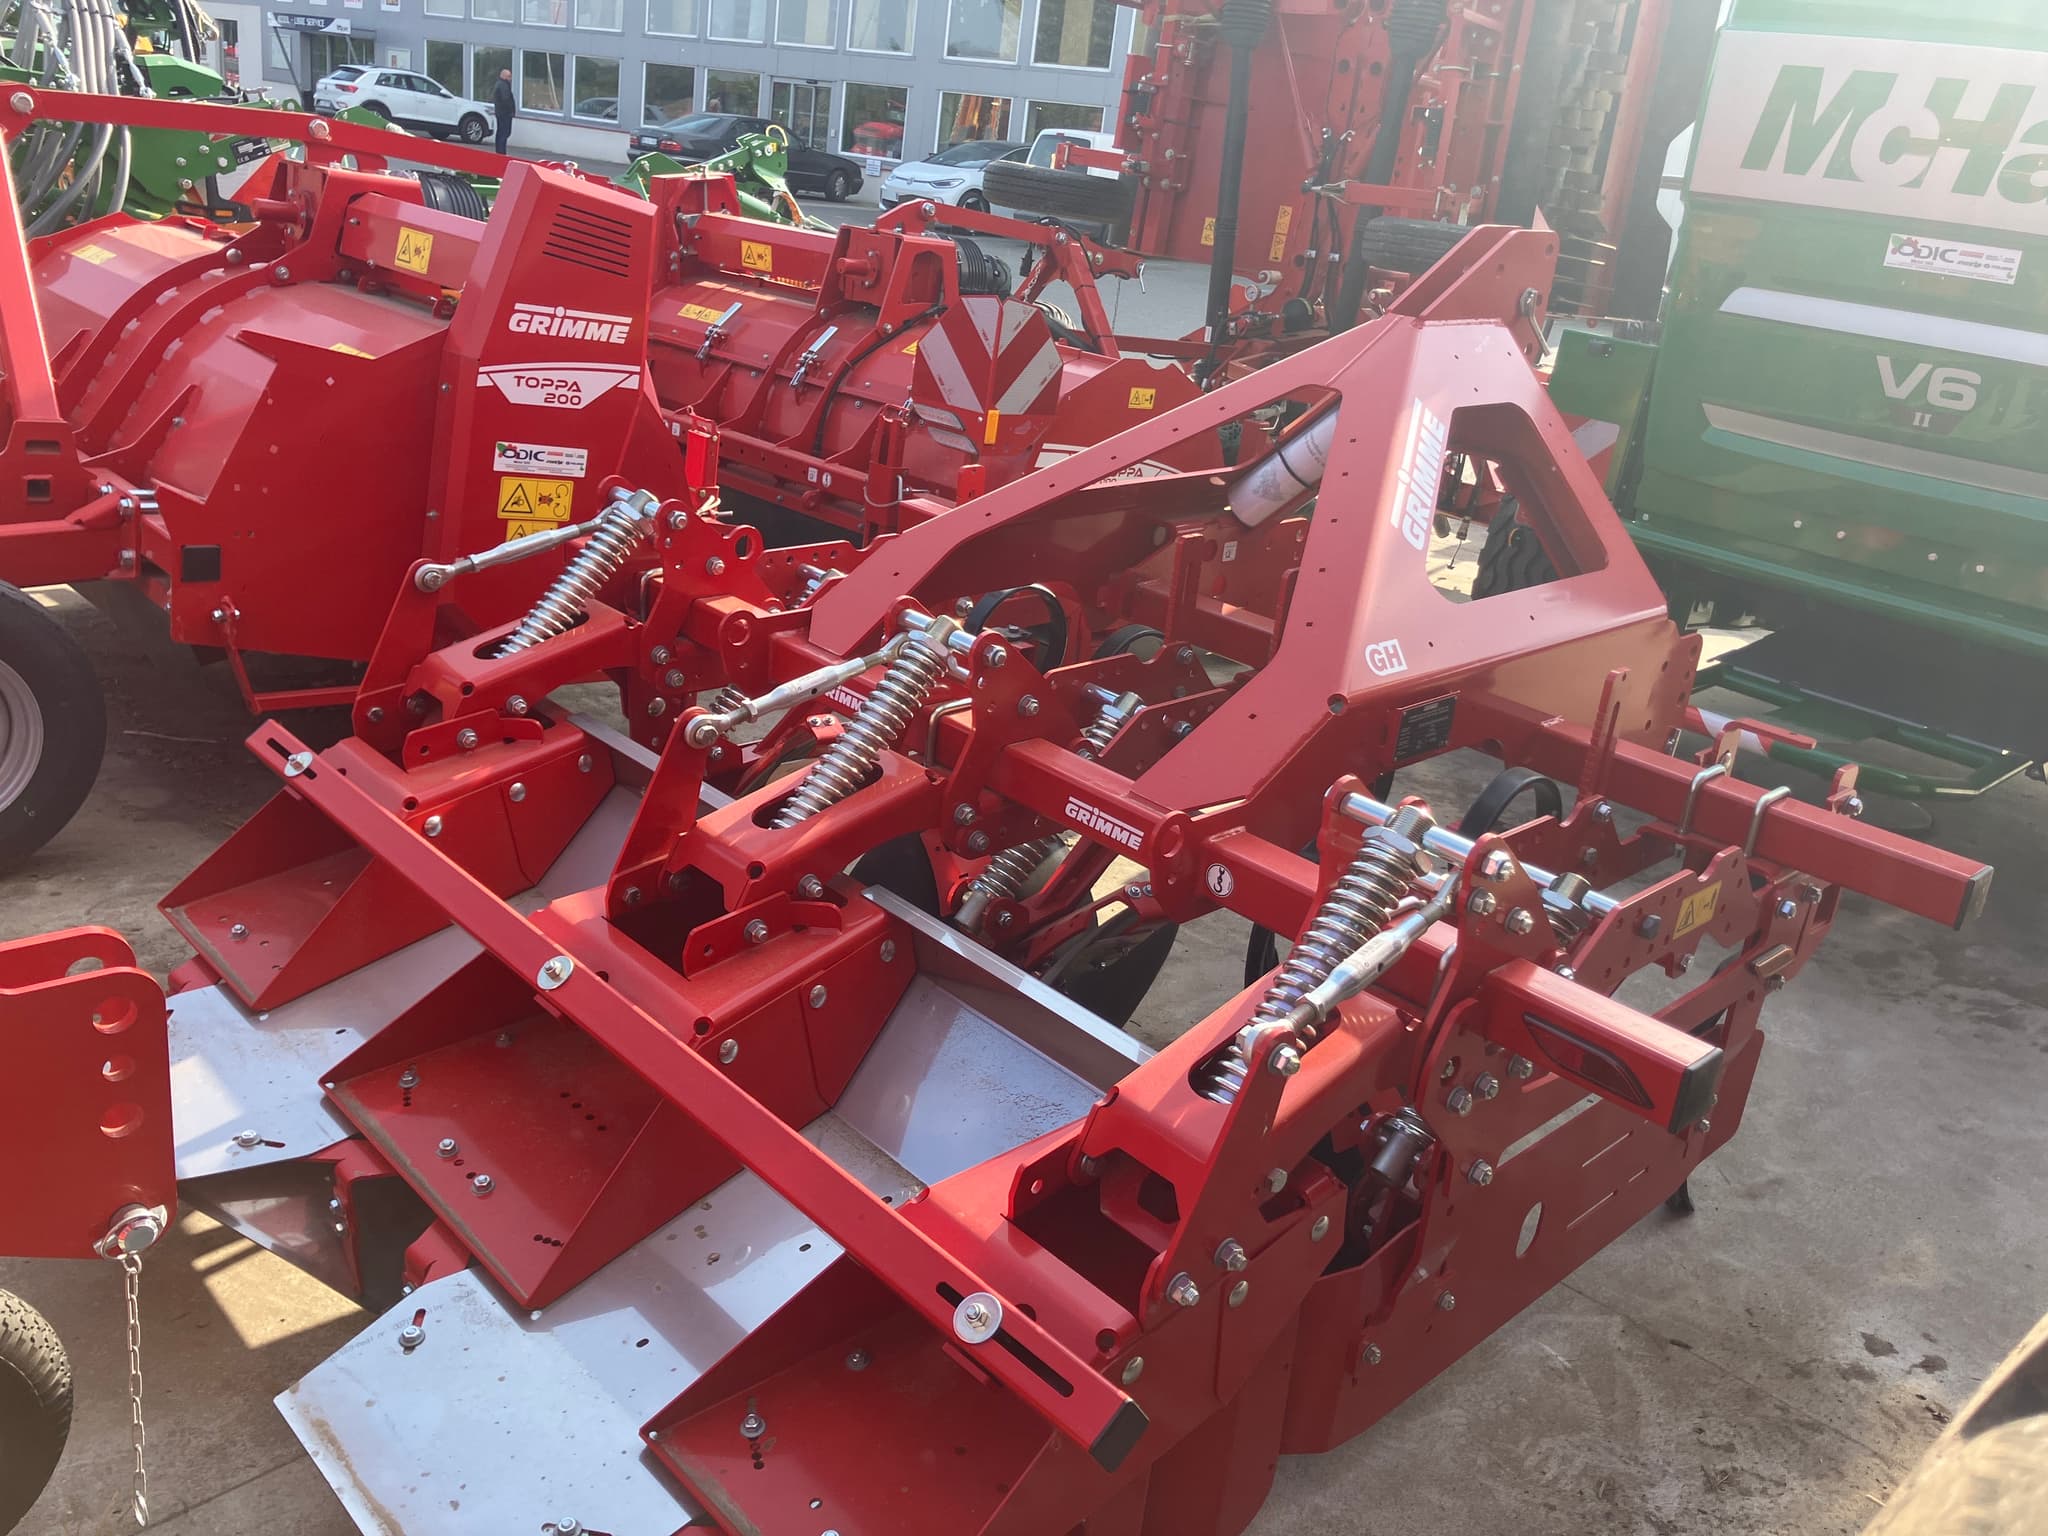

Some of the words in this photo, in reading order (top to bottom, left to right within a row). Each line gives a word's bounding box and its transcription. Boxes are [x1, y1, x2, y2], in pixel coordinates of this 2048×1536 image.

[1898, 244, 1959, 264] ODIC
[508, 298, 632, 344] GRIMME
[513, 374, 582, 393] TOPPA
[1876, 355, 1982, 411] V6
[543, 392, 582, 406] 200
[1912, 411, 1933, 428] II
[503, 449, 546, 462] ODIC
[1396, 402, 1446, 550] GRIMME
[1367, 642, 1404, 673] GH
[1064, 800, 1143, 851] GRIMME
